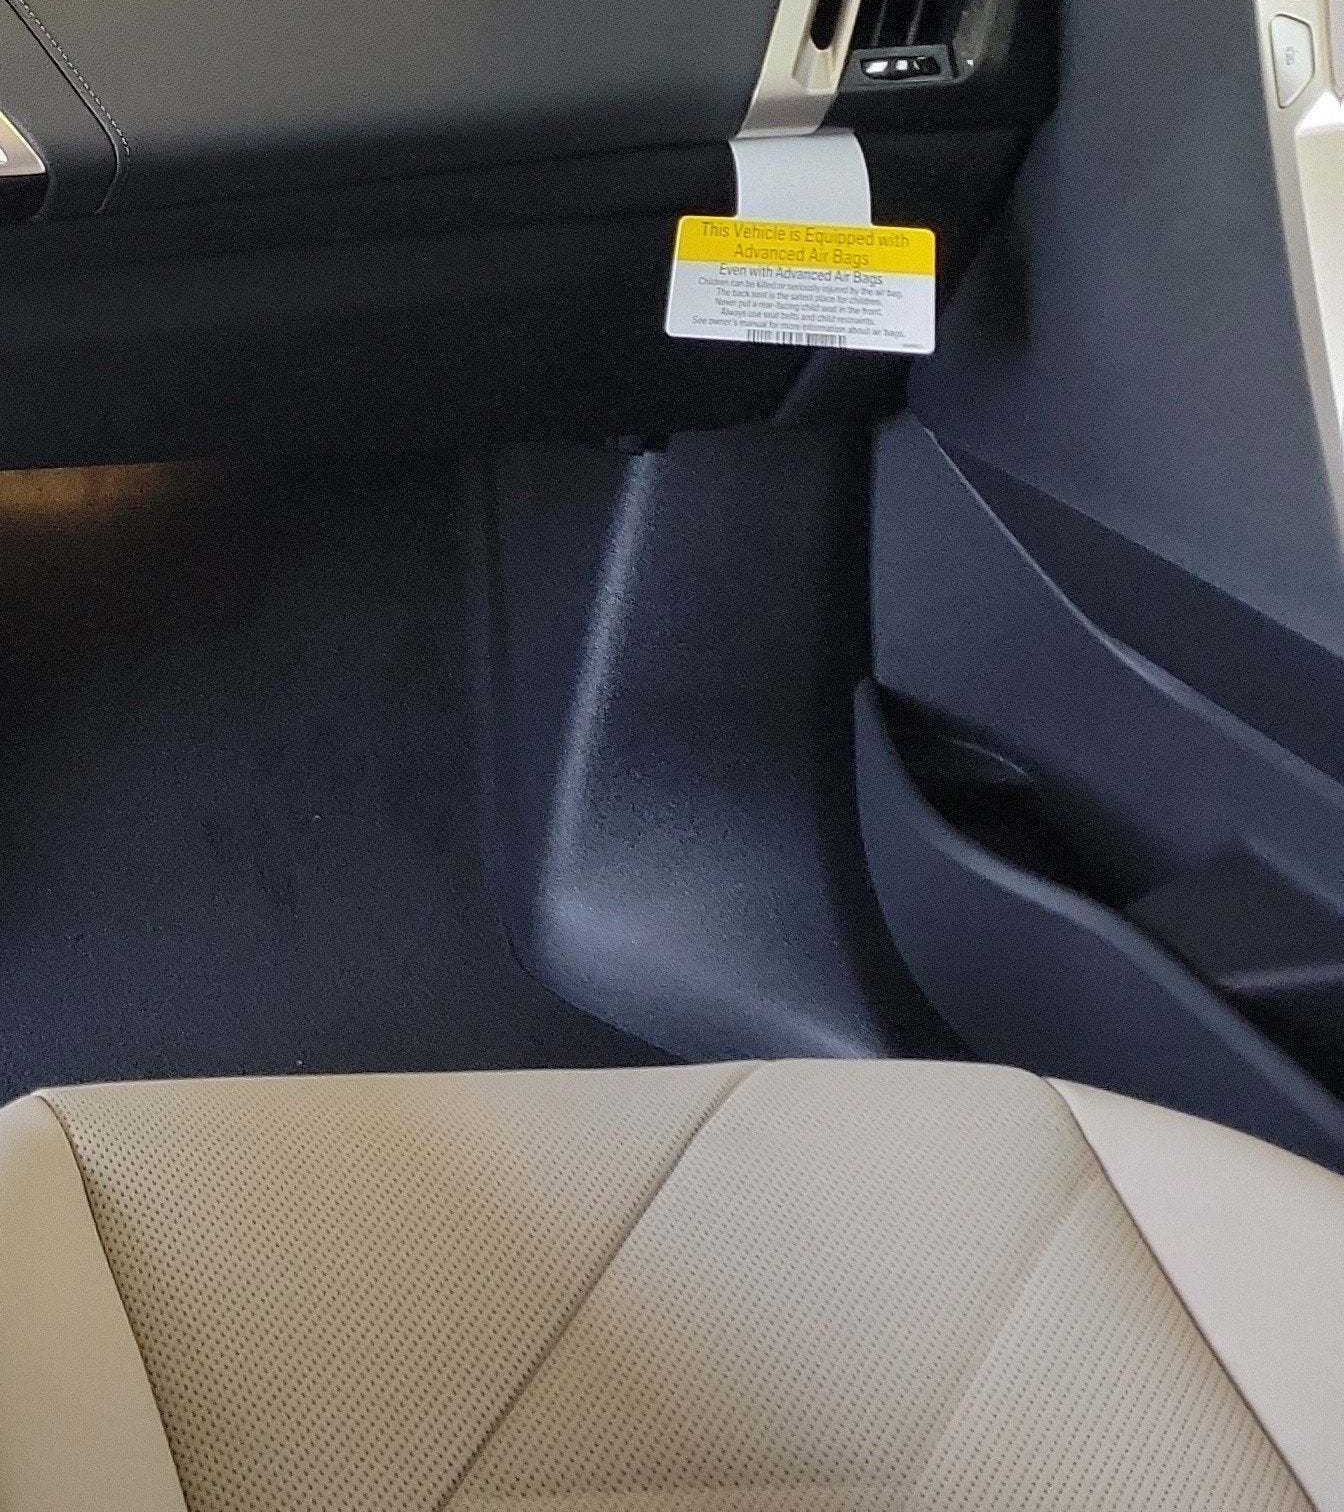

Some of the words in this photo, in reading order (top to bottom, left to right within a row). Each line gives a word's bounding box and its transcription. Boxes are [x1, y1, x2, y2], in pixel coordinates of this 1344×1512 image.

[701, 221, 730, 238] This
[733, 222, 787, 241] Vehicle
[790, 227, 802, 242] is
[804, 227, 875, 247] Equipped
[878, 233, 911, 248] with
[733, 243, 805, 262] Advanced
[808, 247, 829, 263] Air
[832, 248, 870, 269] Bags
[719, 262, 747, 276] Even
[749, 266, 773, 278] with
[775, 266, 832, 282] Advanced
[834, 270, 851, 283] Air
[853, 270, 883, 287] Bags
